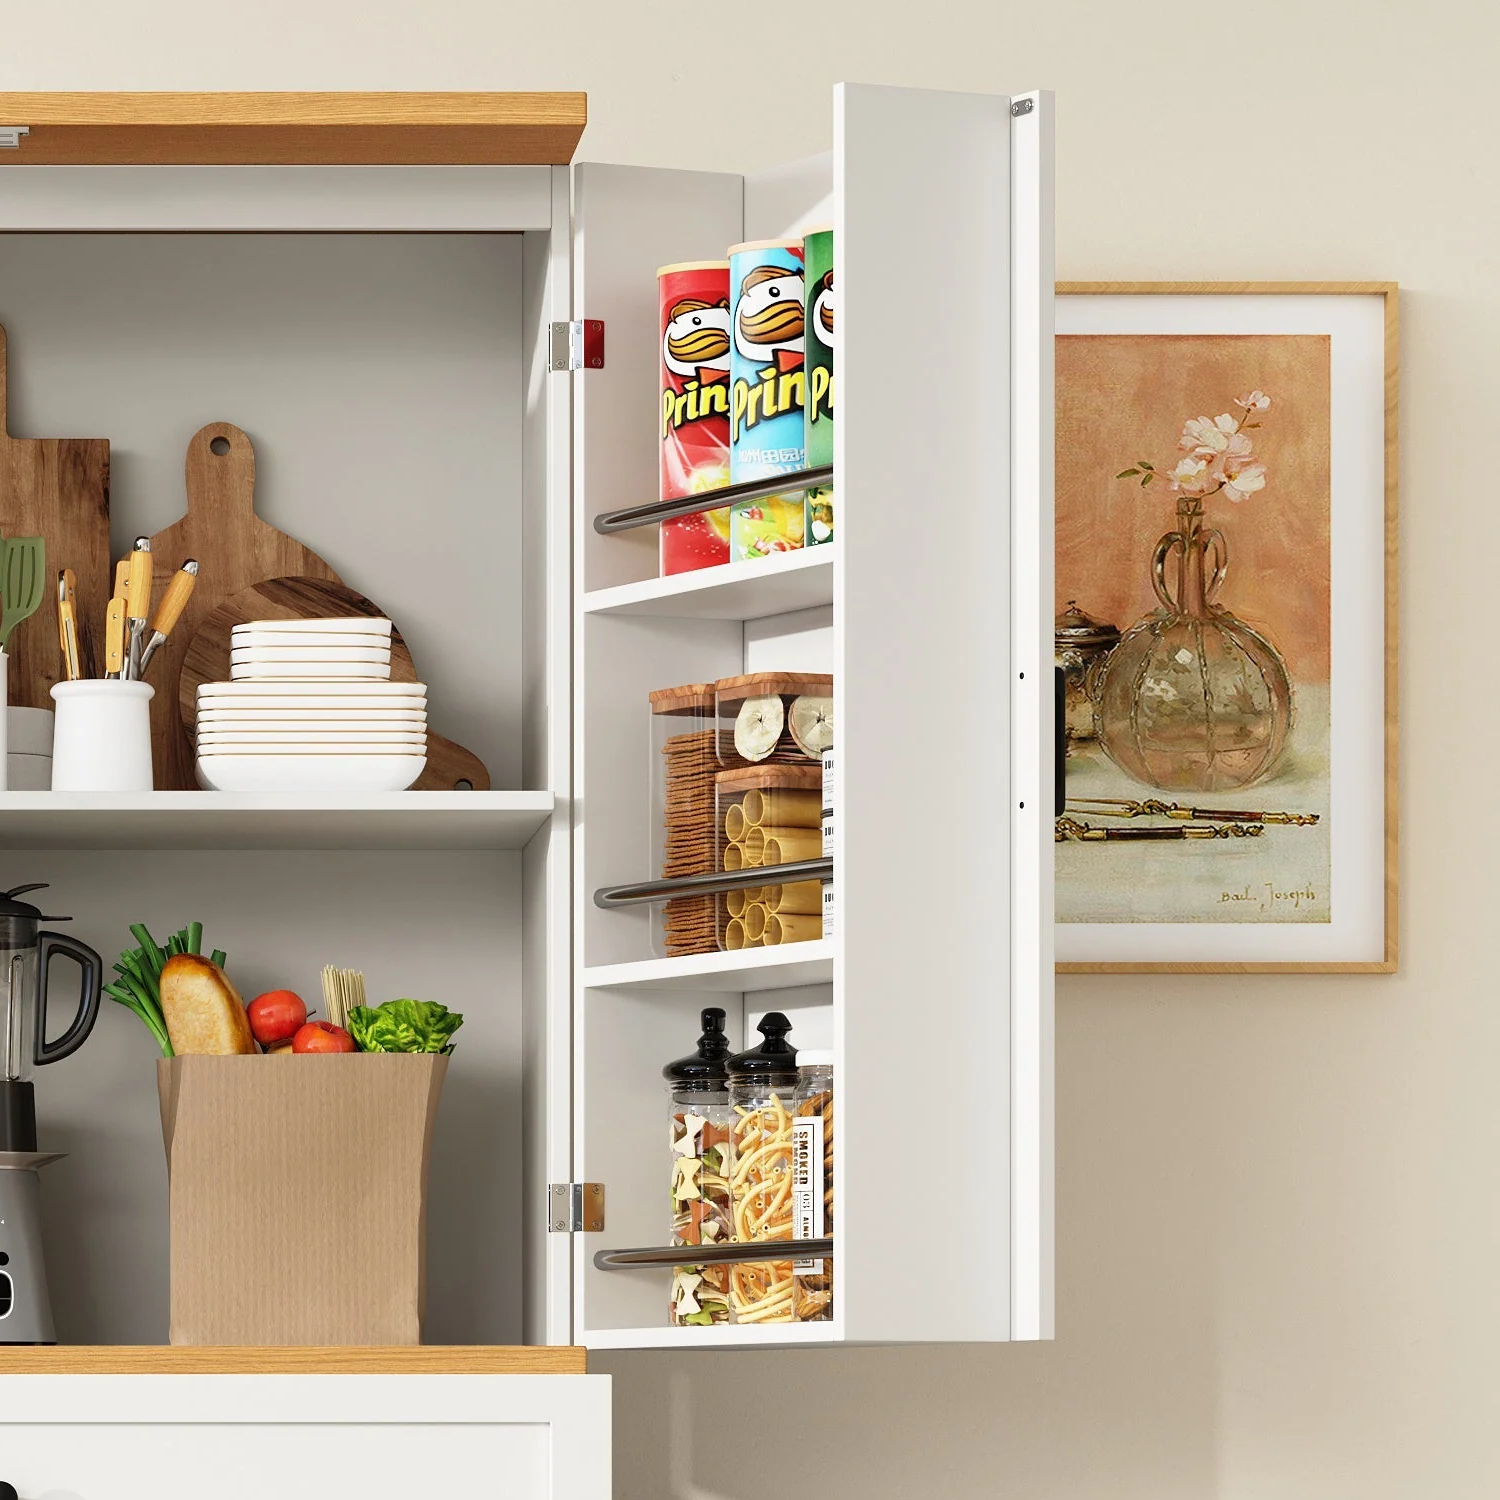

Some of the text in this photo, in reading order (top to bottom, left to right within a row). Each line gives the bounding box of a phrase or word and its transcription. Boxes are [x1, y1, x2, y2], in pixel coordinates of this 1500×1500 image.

[663, 380, 730, 440] Prin
[1264, 882, 1316, 908] Joseph
[799, 1131, 809, 1185] SMOKED
